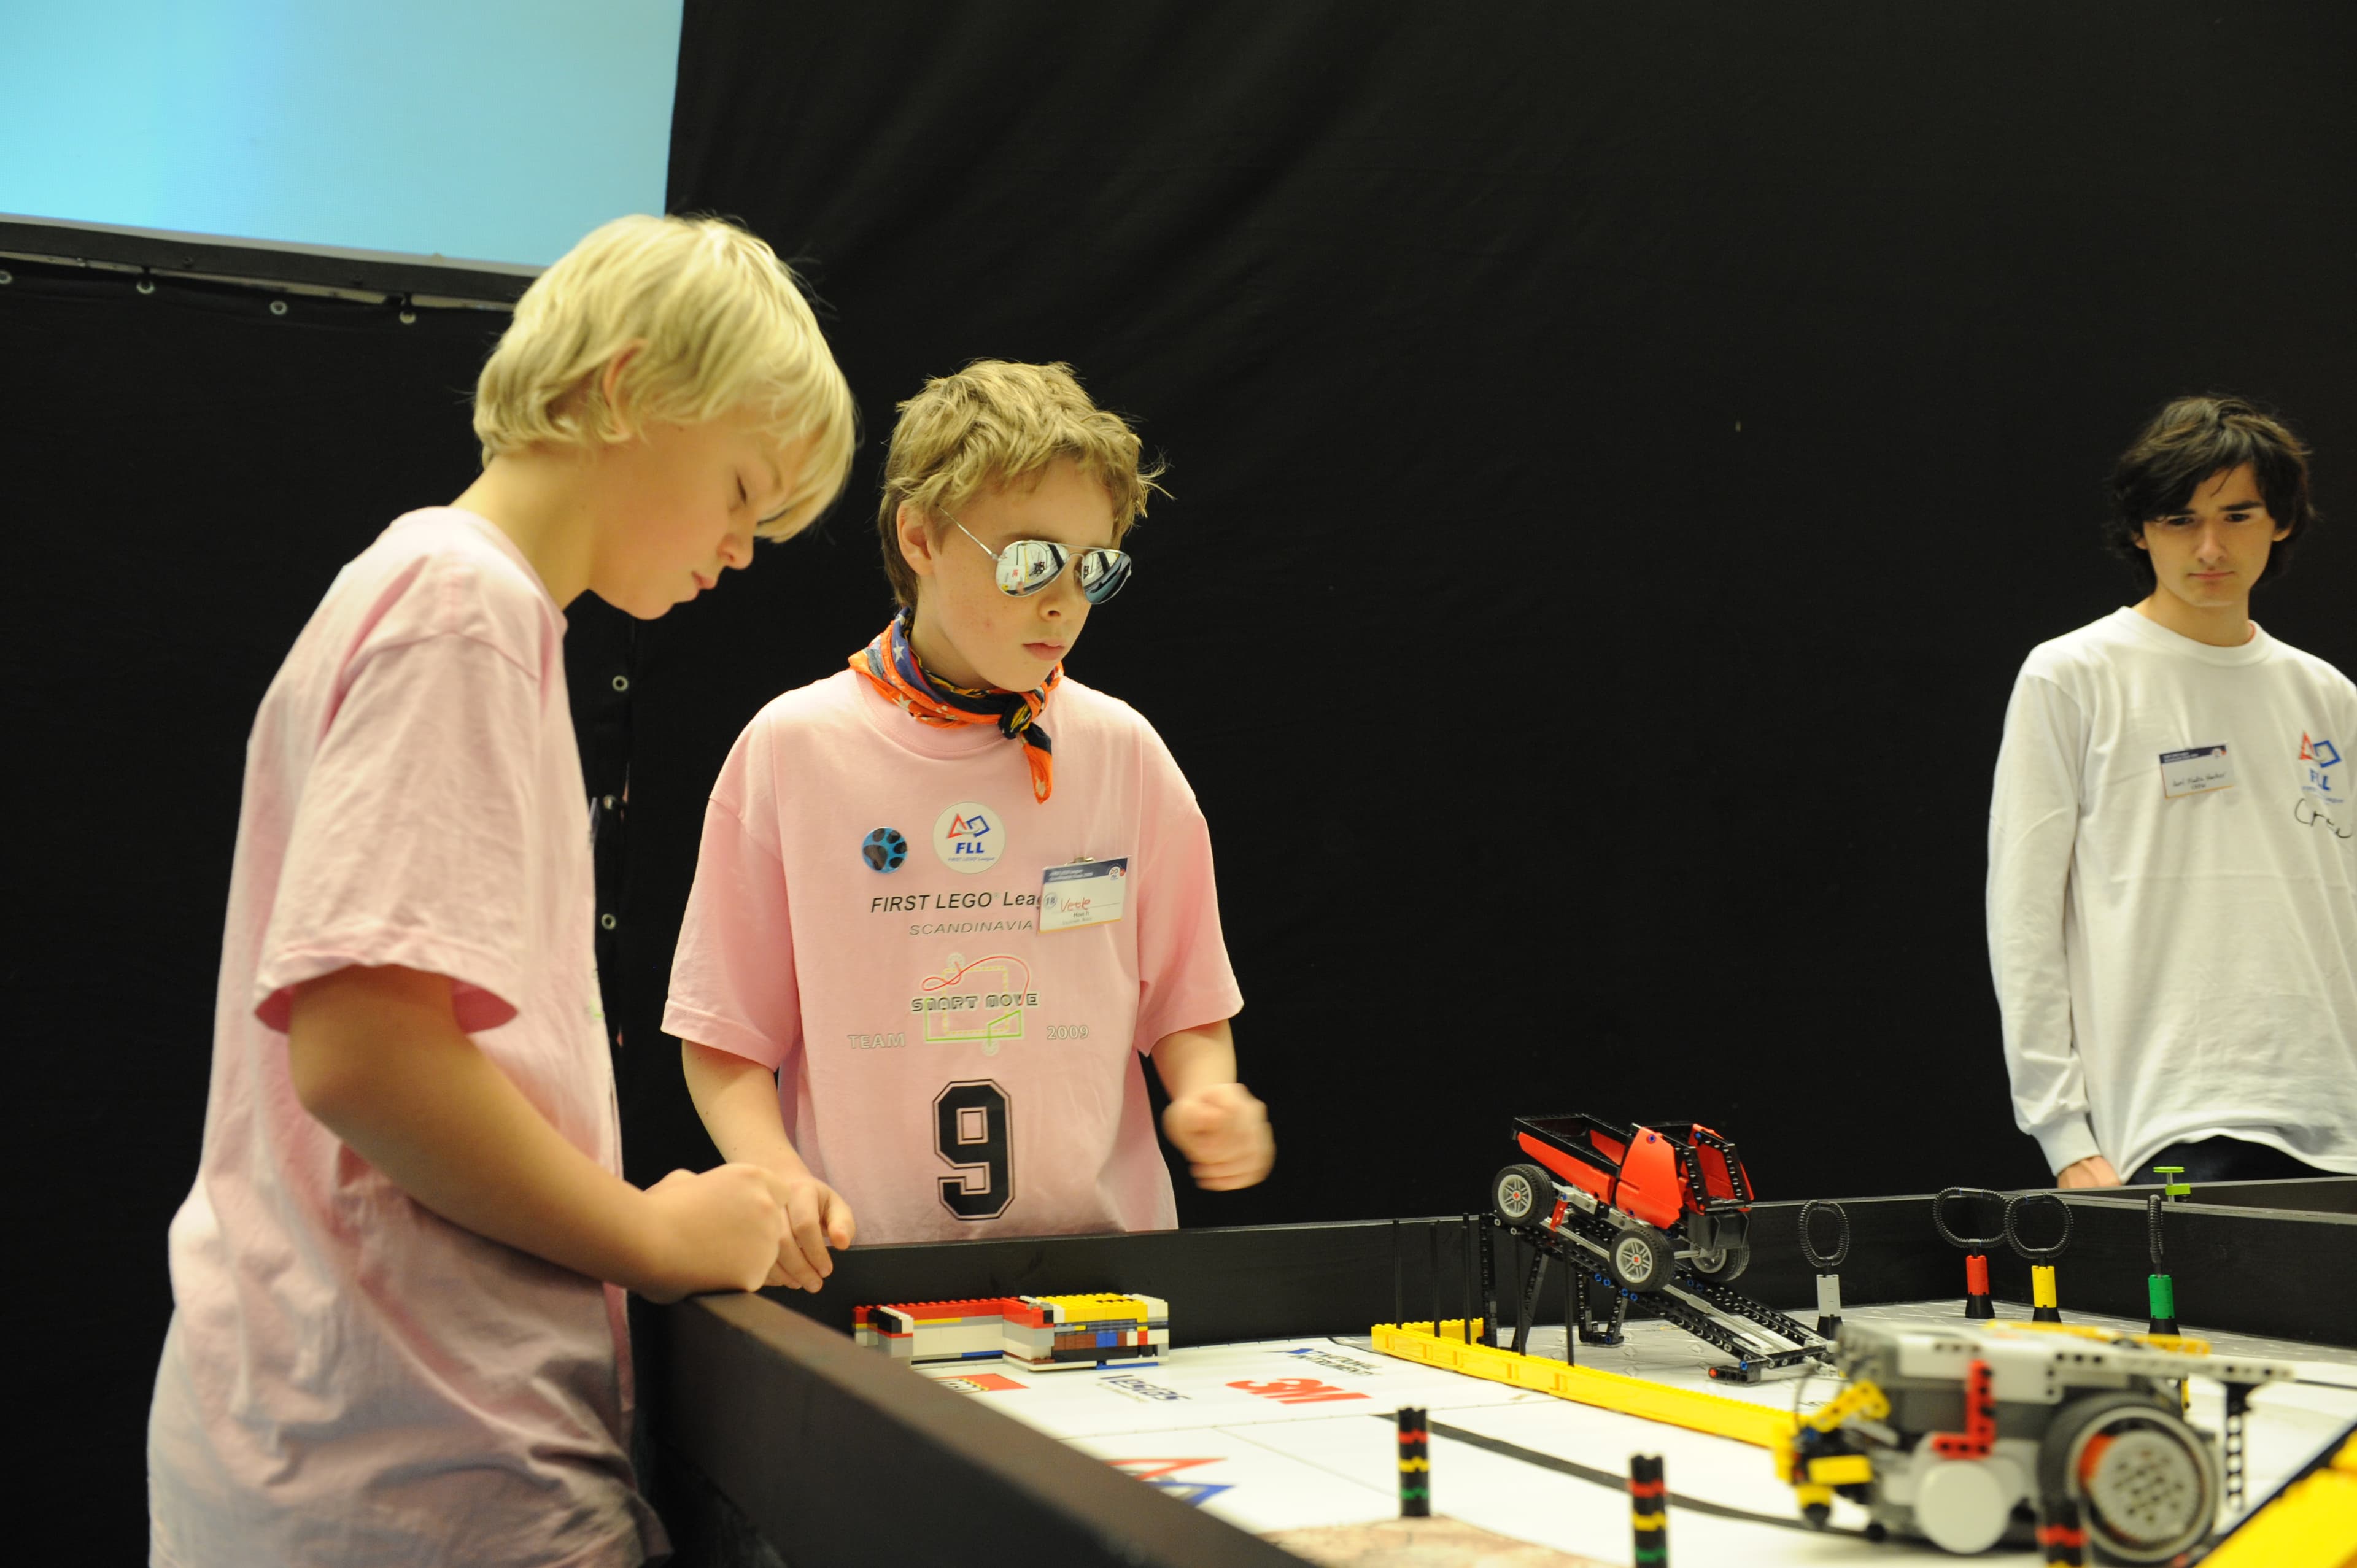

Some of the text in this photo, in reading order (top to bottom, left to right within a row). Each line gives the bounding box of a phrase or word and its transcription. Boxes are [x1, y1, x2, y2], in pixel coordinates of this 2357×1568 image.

[955, 841, 985, 854] FLL
[870, 894, 930, 913] FIRST
[909, 920, 1033, 936] SCANDINAVIA
[911, 992, 1039, 1012] SMART MOVE
[847, 1033, 905, 1049] TEAM
[1046, 1025, 1089, 1040] 2009
[932, 1079, 1015, 1221] 9
[1225, 1378, 1372, 1405] 3M
